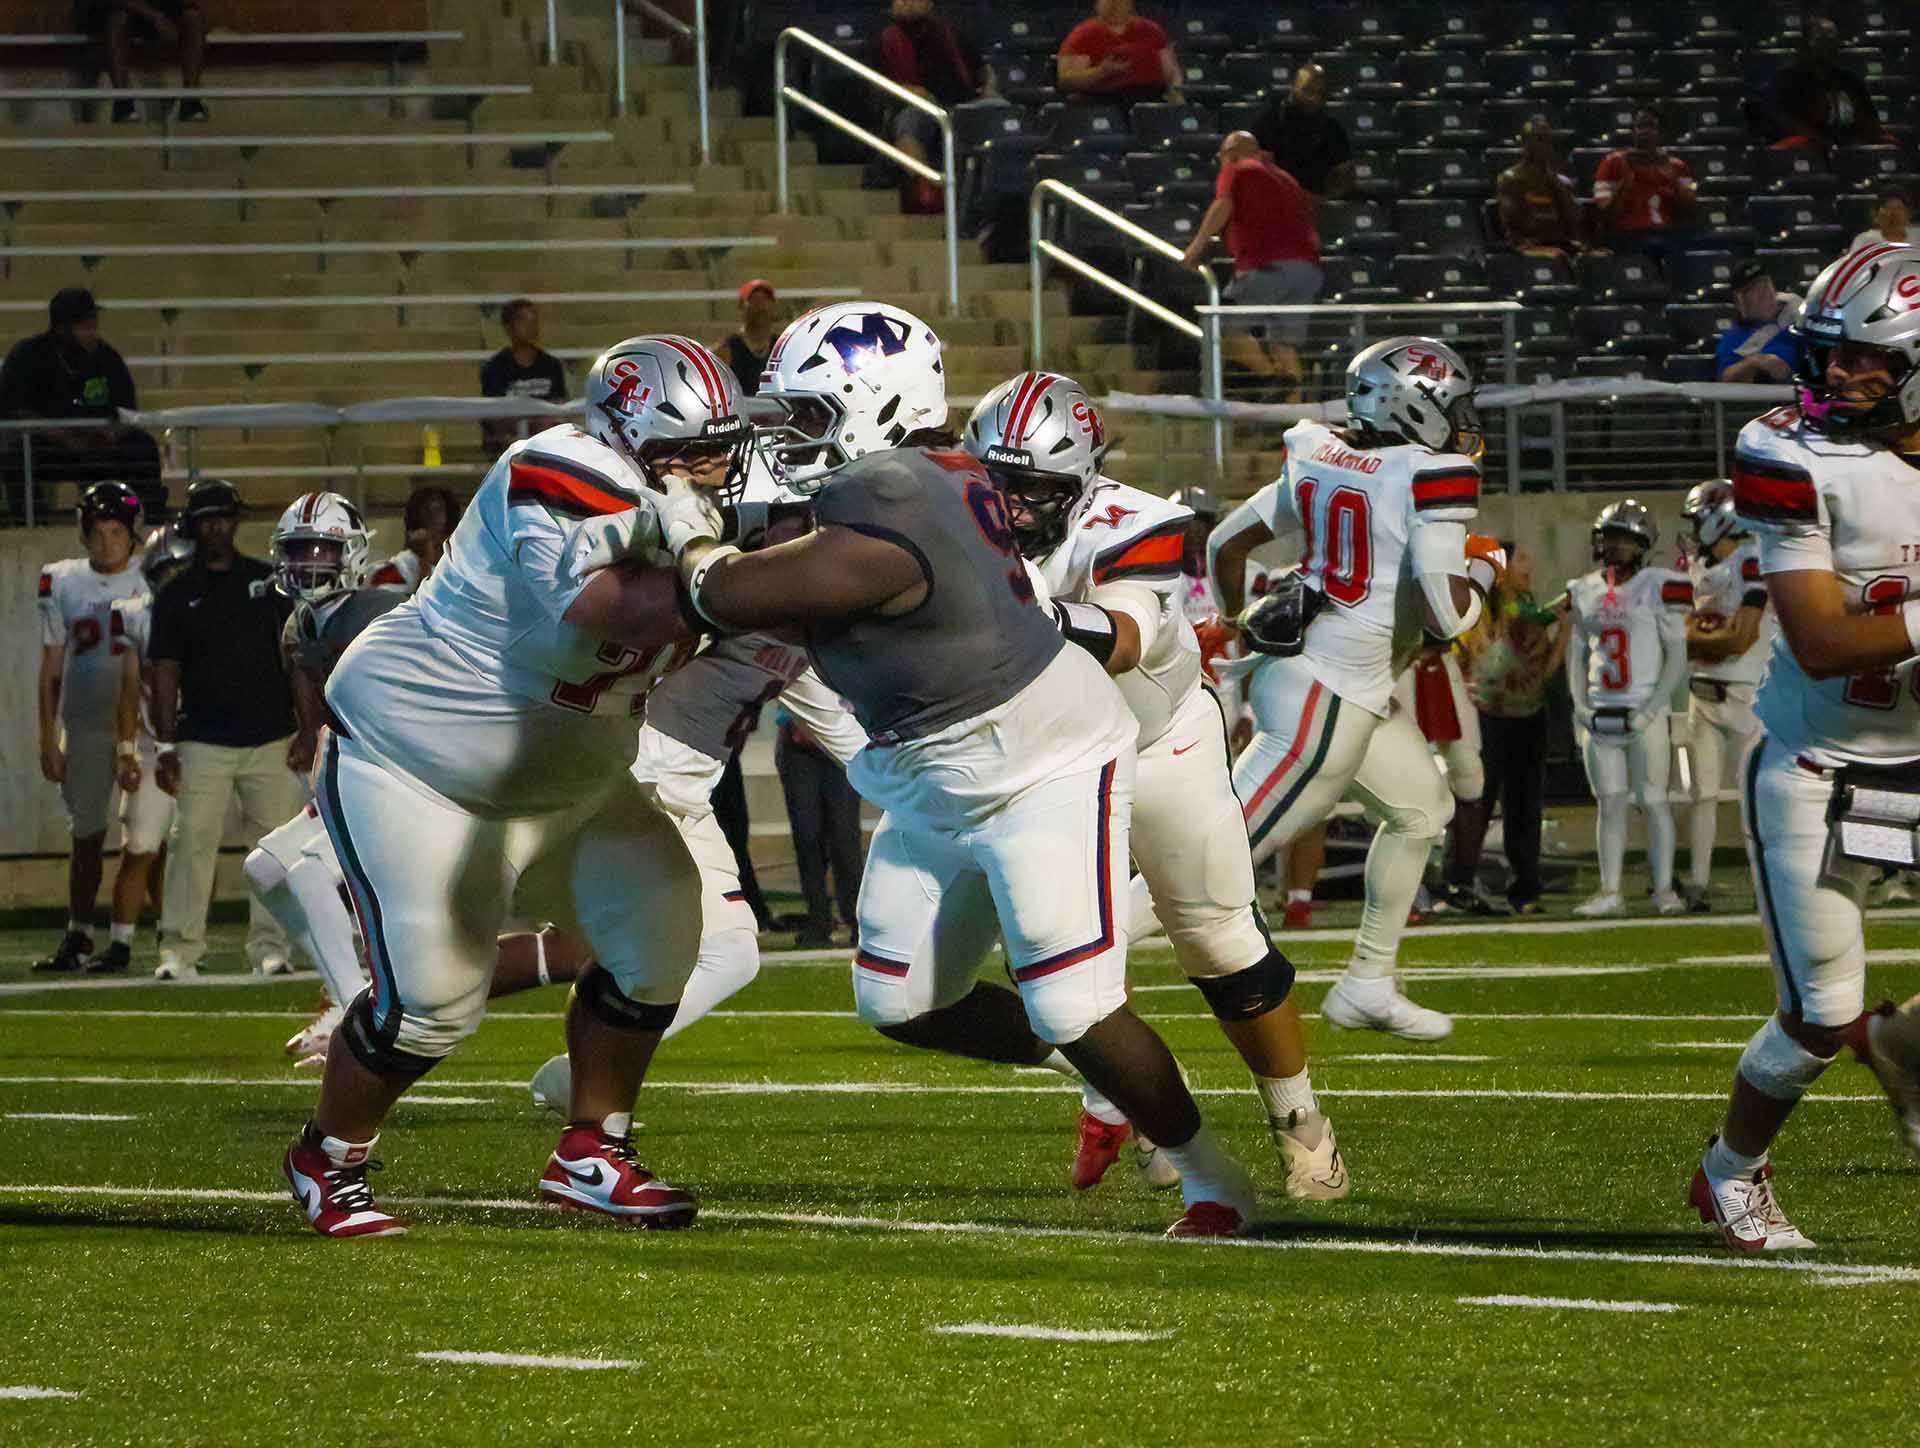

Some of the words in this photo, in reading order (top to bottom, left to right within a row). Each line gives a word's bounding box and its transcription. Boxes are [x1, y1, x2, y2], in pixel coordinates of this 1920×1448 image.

[825, 312, 908, 377] M
[706, 418, 741, 436] Riddell
[987, 449, 1030, 466] Riddell
[1294, 476, 1374, 609] 10
[1599, 626, 1631, 691] 3
